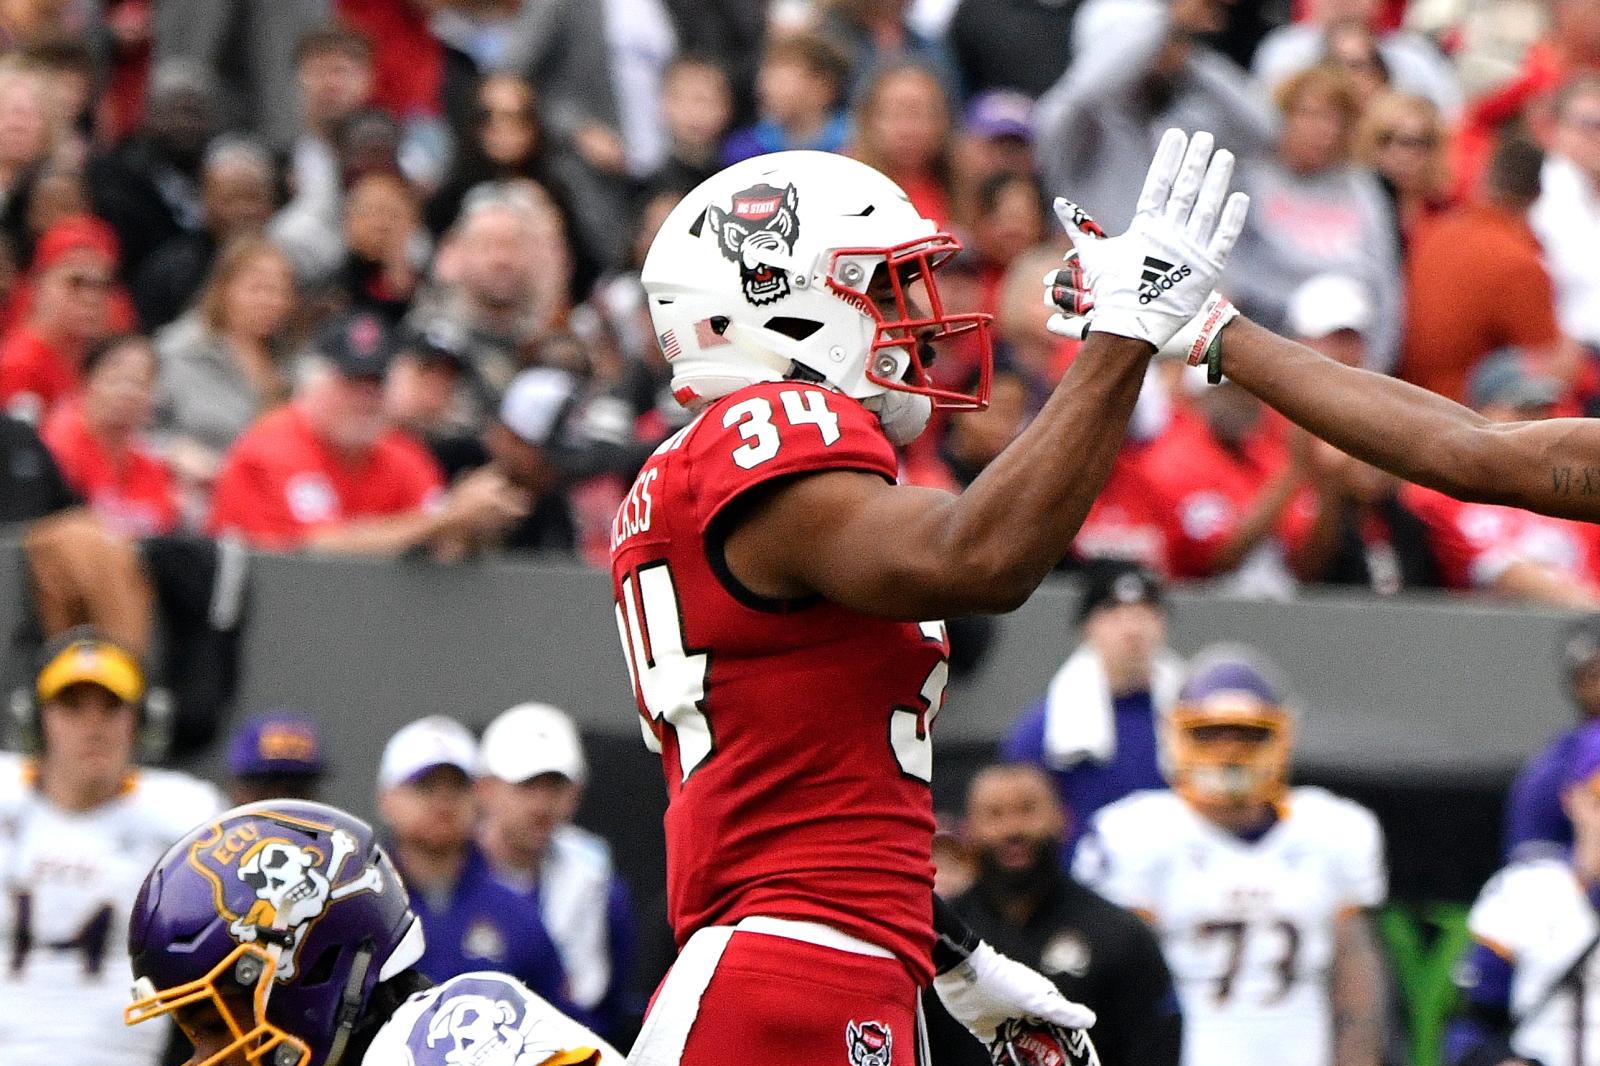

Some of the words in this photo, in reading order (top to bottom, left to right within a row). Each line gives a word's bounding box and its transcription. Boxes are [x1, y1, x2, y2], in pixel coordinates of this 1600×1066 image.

[1139, 264, 1192, 305] adidas
[721, 390, 841, 471] 34
[614, 556, 714, 787] 4
[211, 821, 258, 866] ECU
[1197, 918, 1302, 1009] 73
